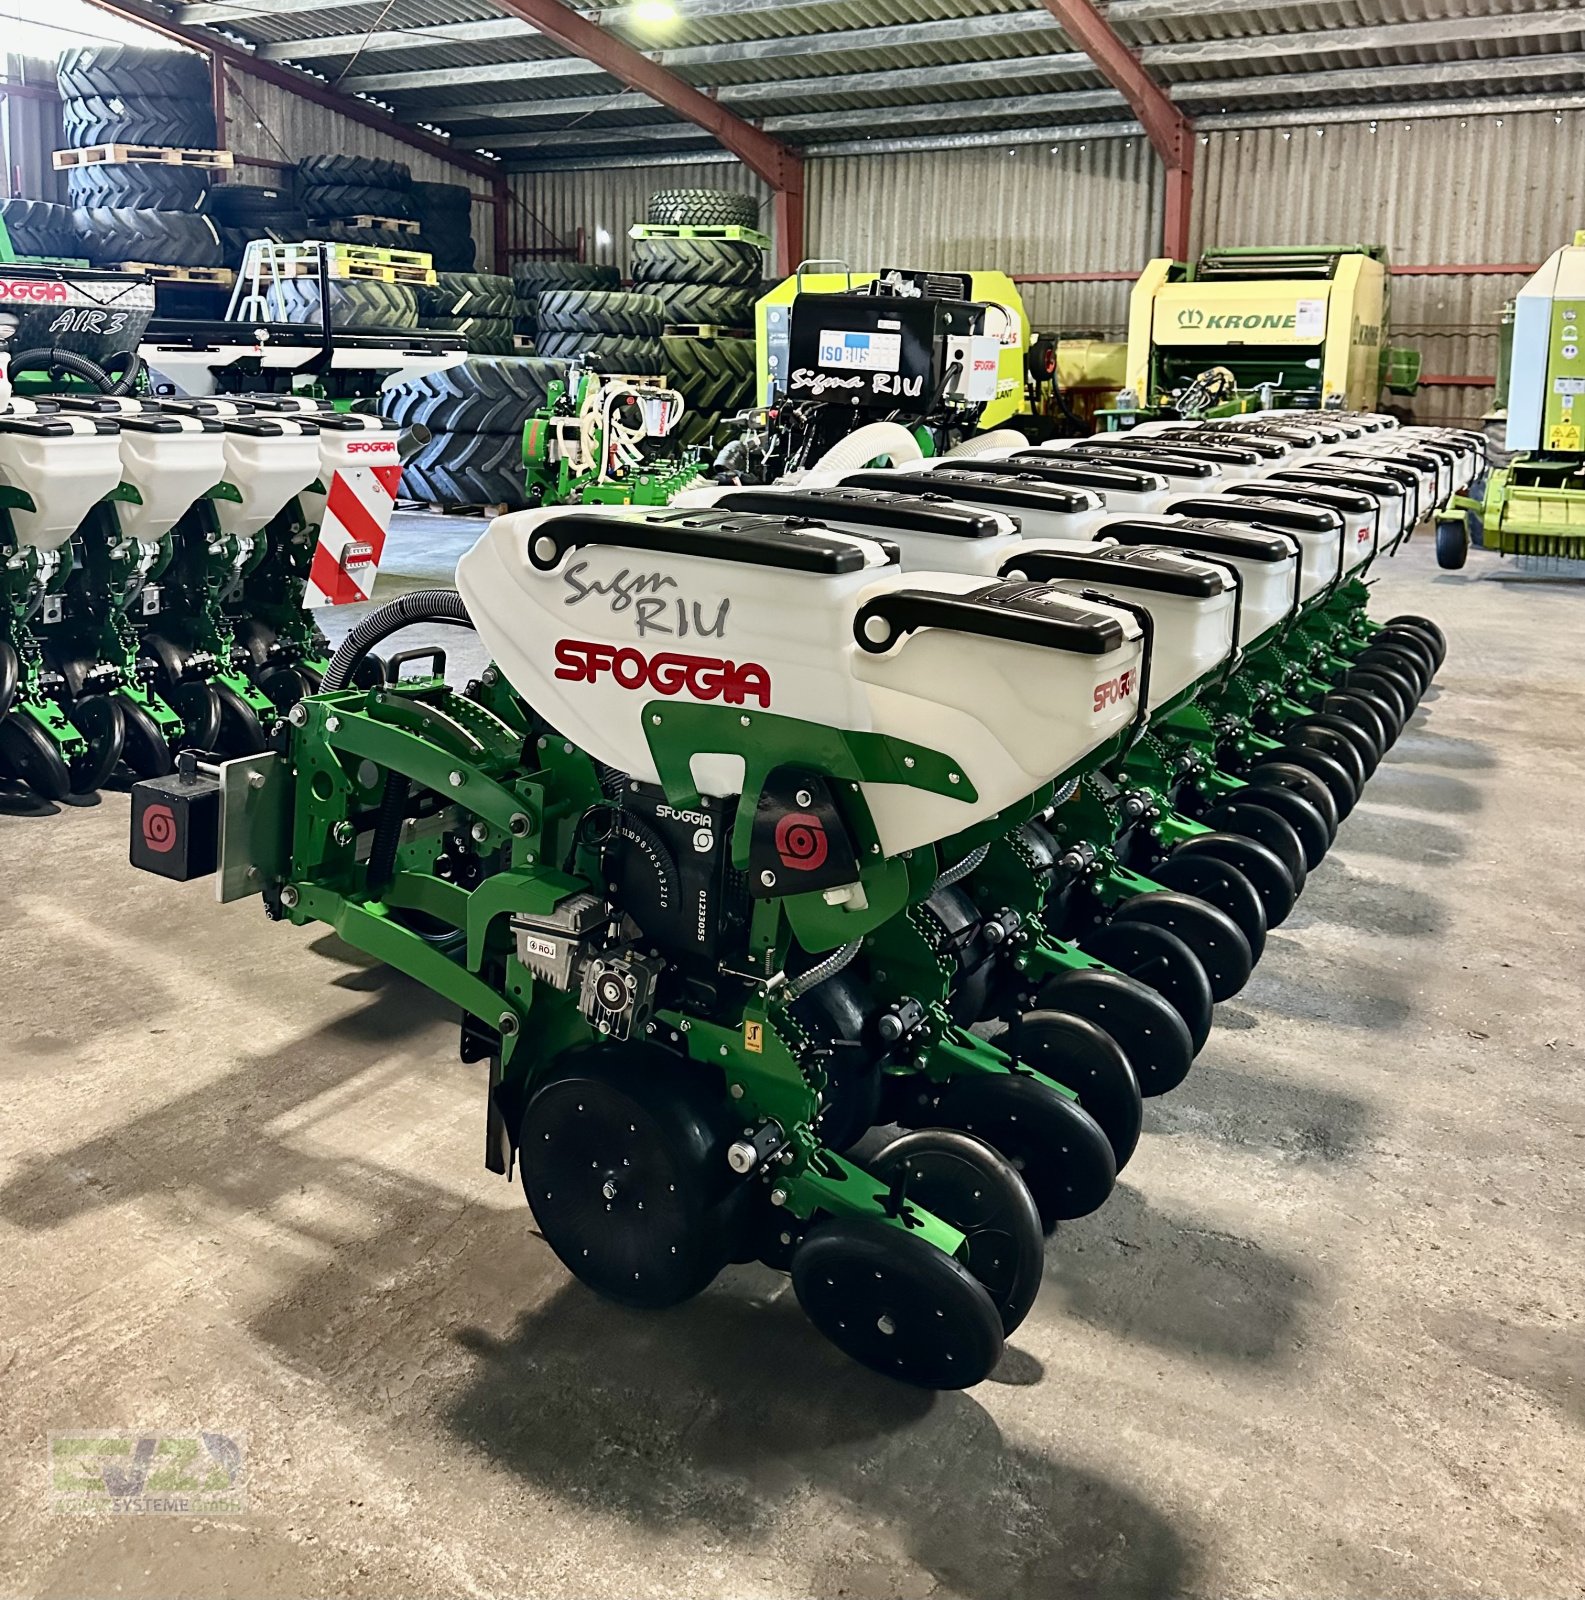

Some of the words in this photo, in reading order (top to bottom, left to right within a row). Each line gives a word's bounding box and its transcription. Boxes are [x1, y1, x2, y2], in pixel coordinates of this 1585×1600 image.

[1206, 315, 1296, 328] KRONE
[790, 368, 865, 395] Sigma
[872, 373, 923, 397] RIU
[347, 442, 396, 454] SFOGGIA
[635, 597, 731, 638] RIU
[554, 638, 771, 708] SFOGGIA
[655, 804, 712, 828] SFOGGIA
[635, 835, 641, 843] 9
[640, 840, 647, 848] 8
[645, 846, 653, 854] 7
[650, 853, 657, 861] 6
[697, 890, 707, 942] 01233055
